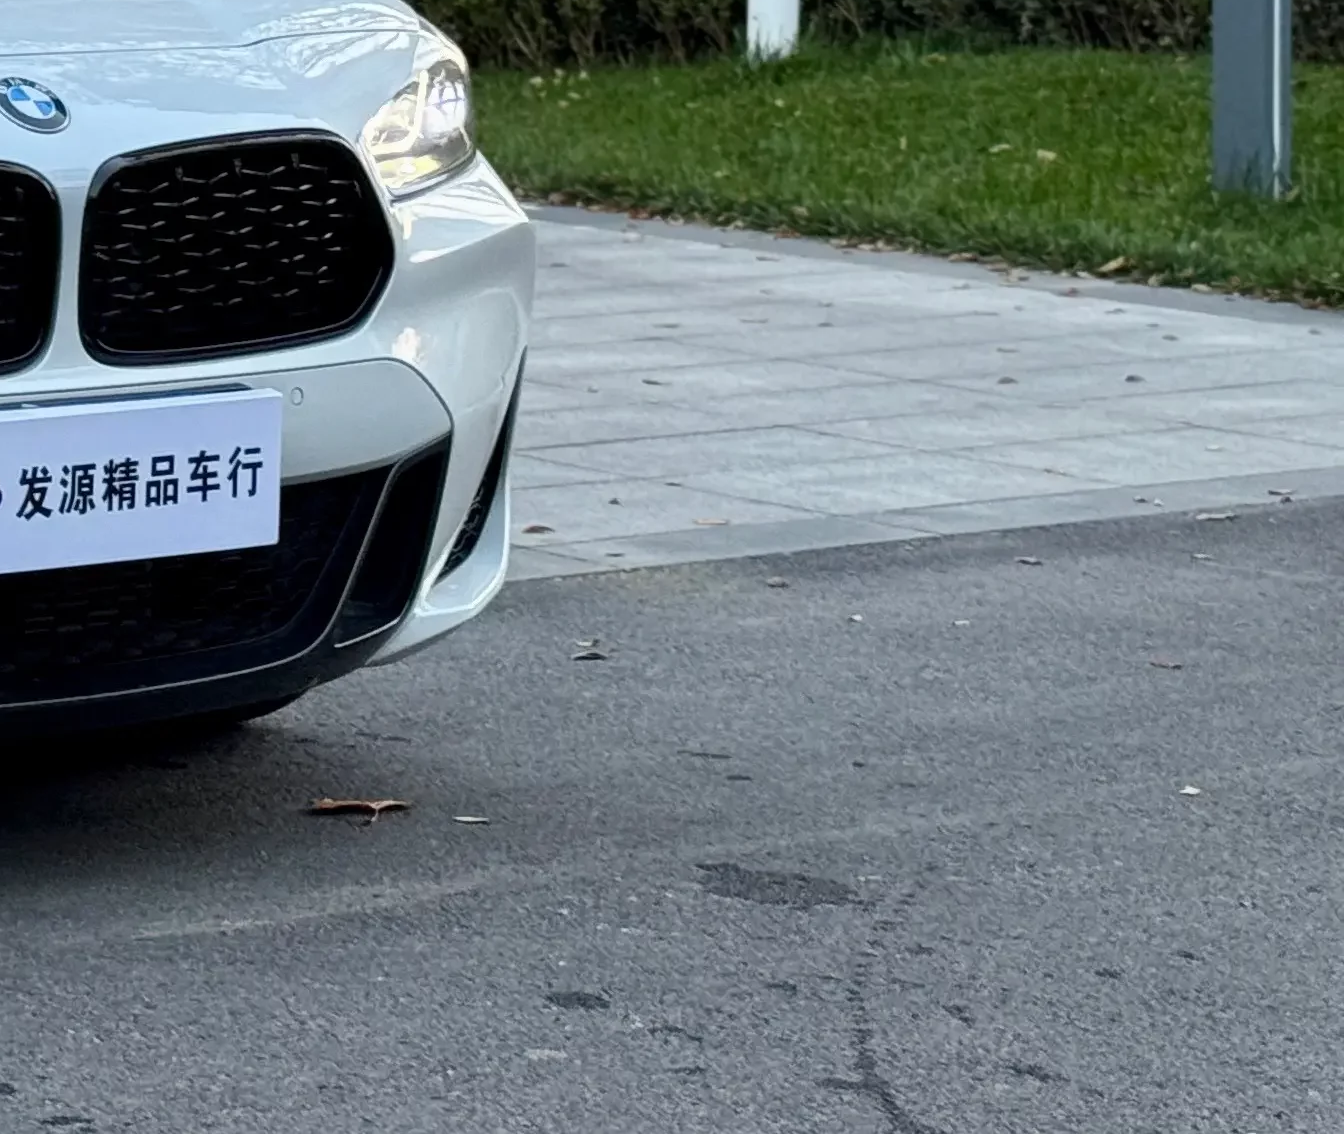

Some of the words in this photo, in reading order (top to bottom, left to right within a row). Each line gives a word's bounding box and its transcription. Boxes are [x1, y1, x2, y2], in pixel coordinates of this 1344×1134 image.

[15, 446, 263, 520] 发源精品车行
